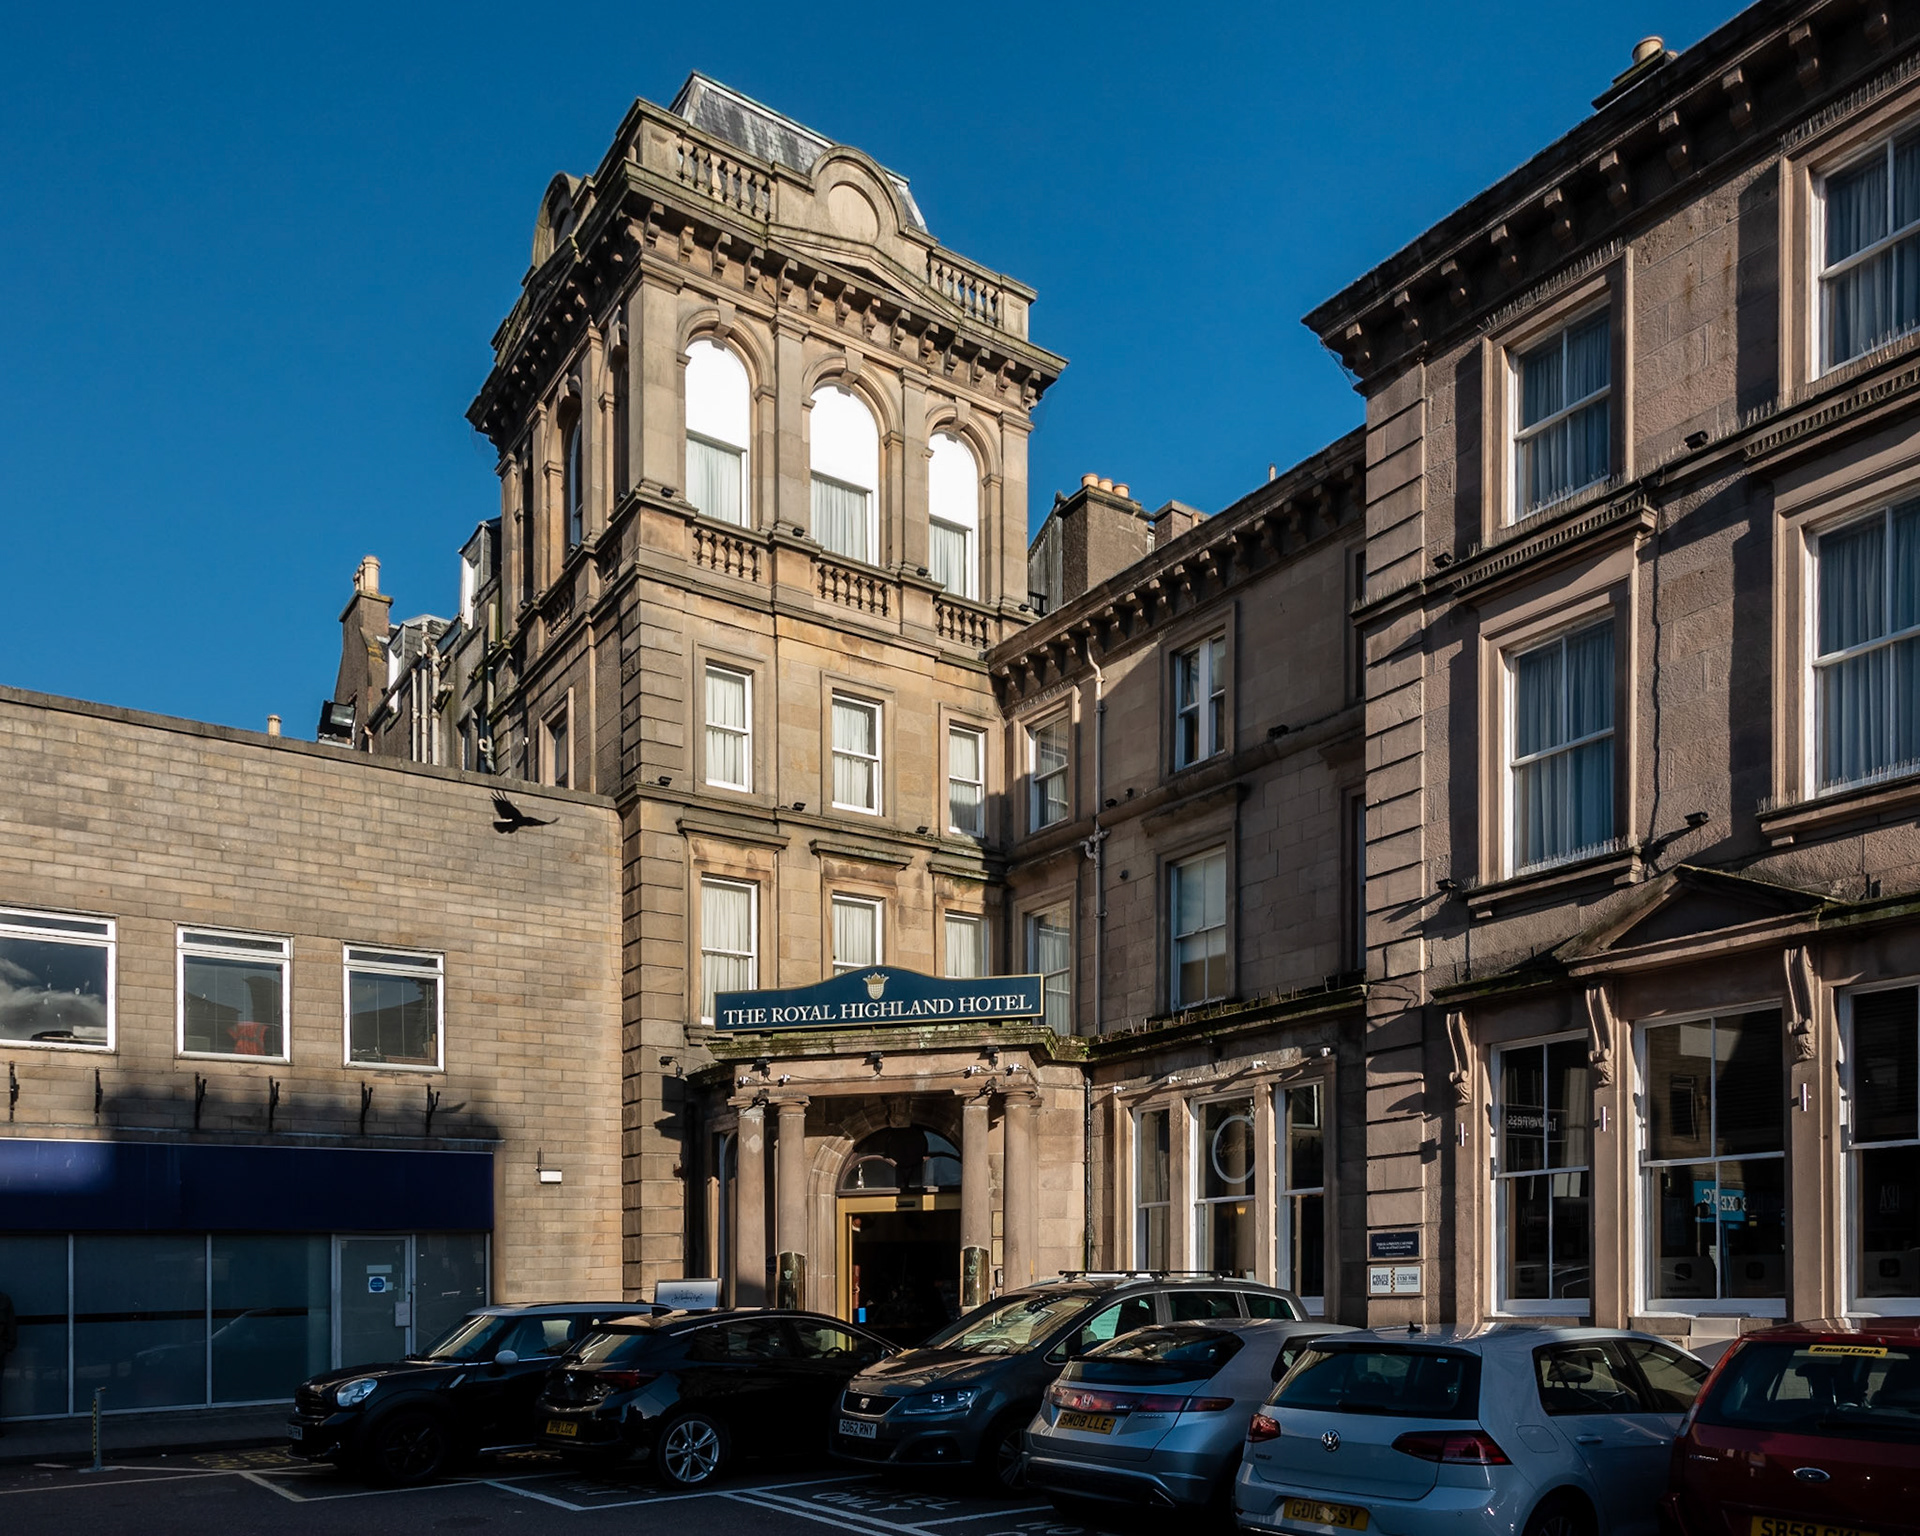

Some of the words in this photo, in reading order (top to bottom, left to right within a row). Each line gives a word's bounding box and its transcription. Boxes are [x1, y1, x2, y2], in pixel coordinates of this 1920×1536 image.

[723, 1008, 767, 1025] THE
[771, 1004, 836, 1023] ROYAL
[840, 998, 954, 1019] HIGHLAND
[958, 994, 1033, 1013] HOTEL
[1813, 1346, 1850, 1354] Arnold
[1851, 1347, 1883, 1355] Clark
[1087, 1415, 1111, 1431] LLE
[812, 1492, 912, 1512] ONLY
